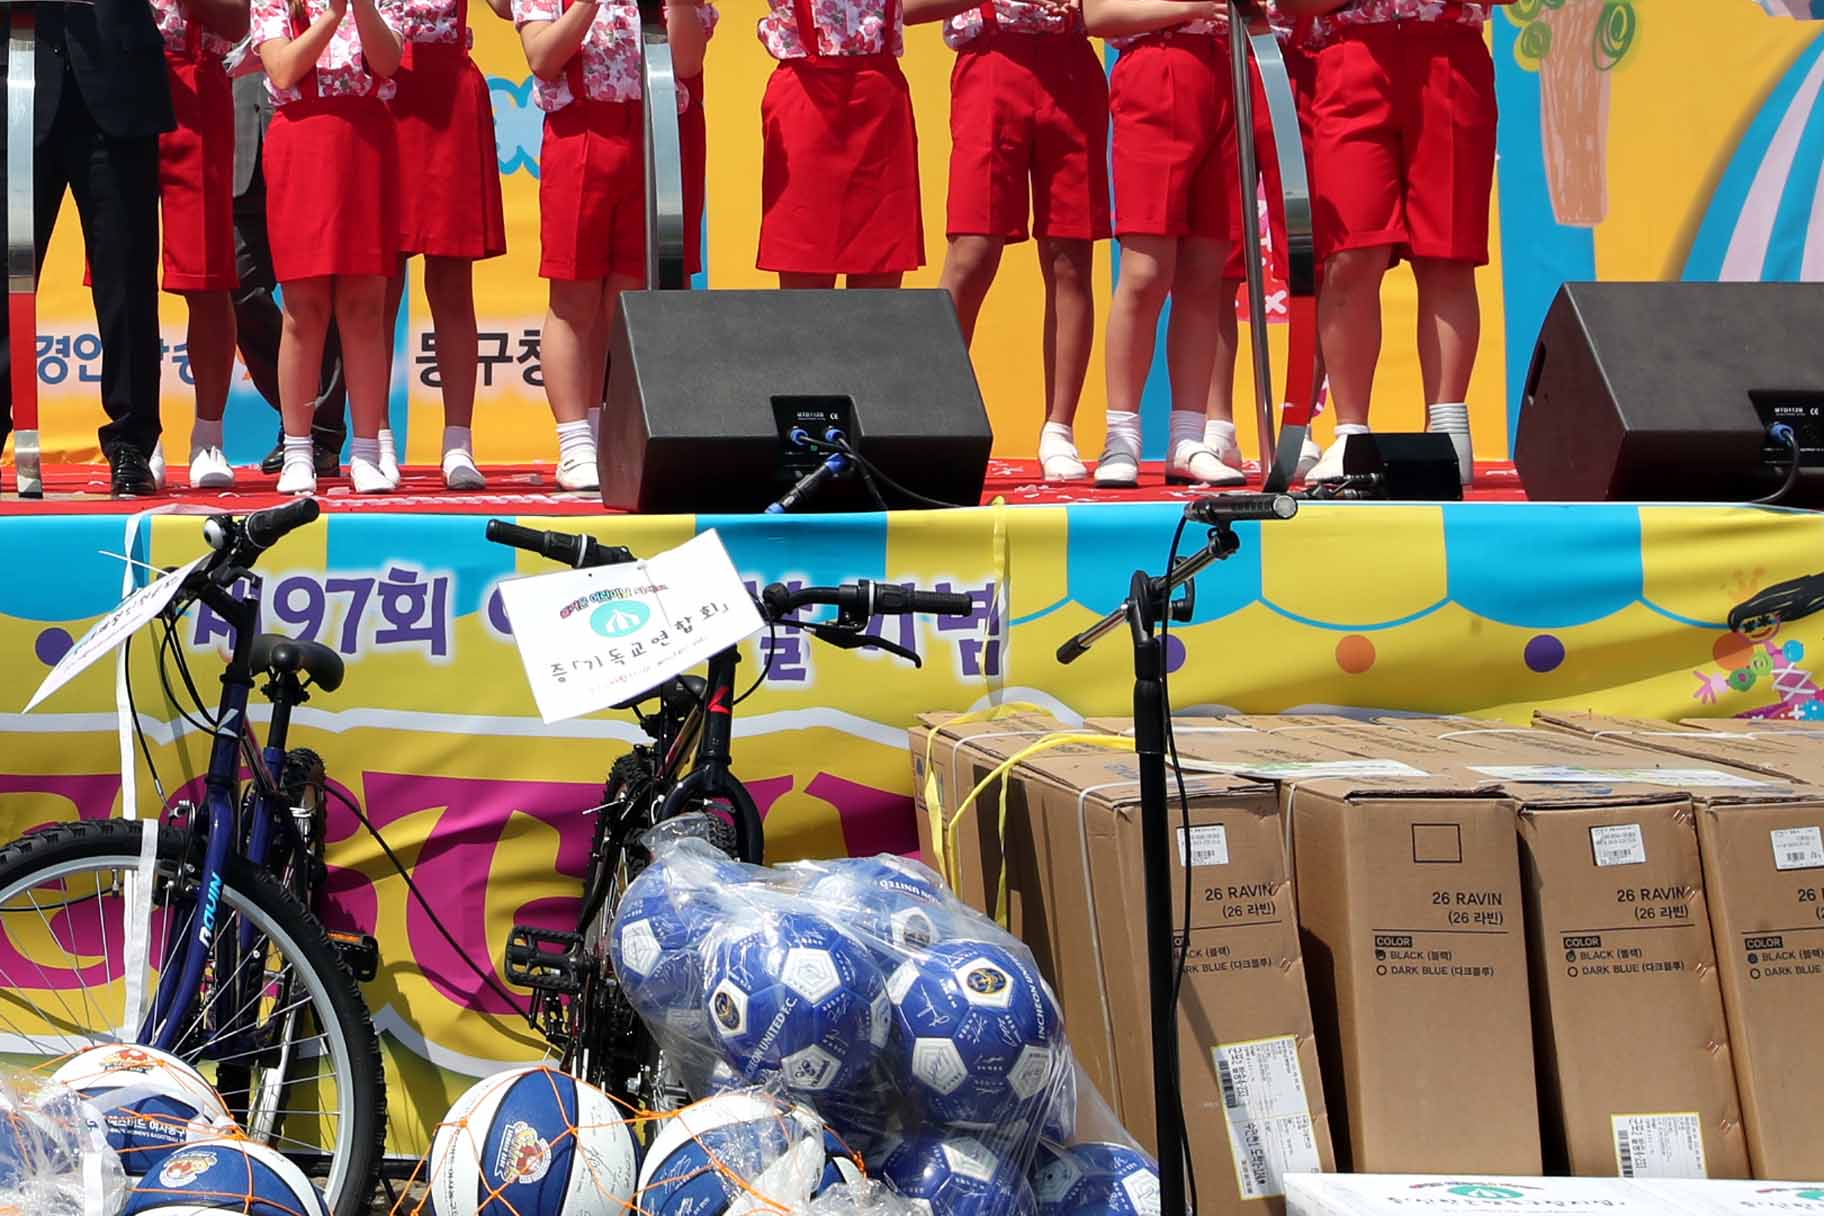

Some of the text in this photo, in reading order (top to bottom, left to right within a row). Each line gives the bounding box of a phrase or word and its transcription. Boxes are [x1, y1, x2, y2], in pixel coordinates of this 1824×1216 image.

[1205, 883, 1275, 902] 26 RAVIN
[1432, 891, 1503, 906] 26 RAVIN
[1616, 886, 1686, 902] 26 RAVIN
[1797, 888, 1817, 902] 26
[1222, 903, 1276, 919] (26 라빈)
[1634, 904, 1689, 921] (26 라빈)
[1448, 911, 1504, 926] (26 라빈)
[1376, 937, 1411, 947] COLOR
[1565, 937, 1600, 948] COLOR
[1746, 938, 1781, 949] COLOR
[1390, 951, 1425, 960] BLACK
[1580, 951, 1615, 961] BLACK
[1762, 951, 1798, 962] BLACK
[1182, 964, 1199, 974] ARK
[1202, 962, 1228, 973] BLUE
[1391, 966, 1419, 976] DARK
[1422, 966, 1448, 976] BLUE
[1582, 966, 1610, 976] DARK
[1613, 963, 1640, 973] BLUE
[1764, 964, 1823, 977] DARK BLUE
[1030, 983, 1047, 1040] INCHEON
[759, 1012, 786, 1051] UNITED
